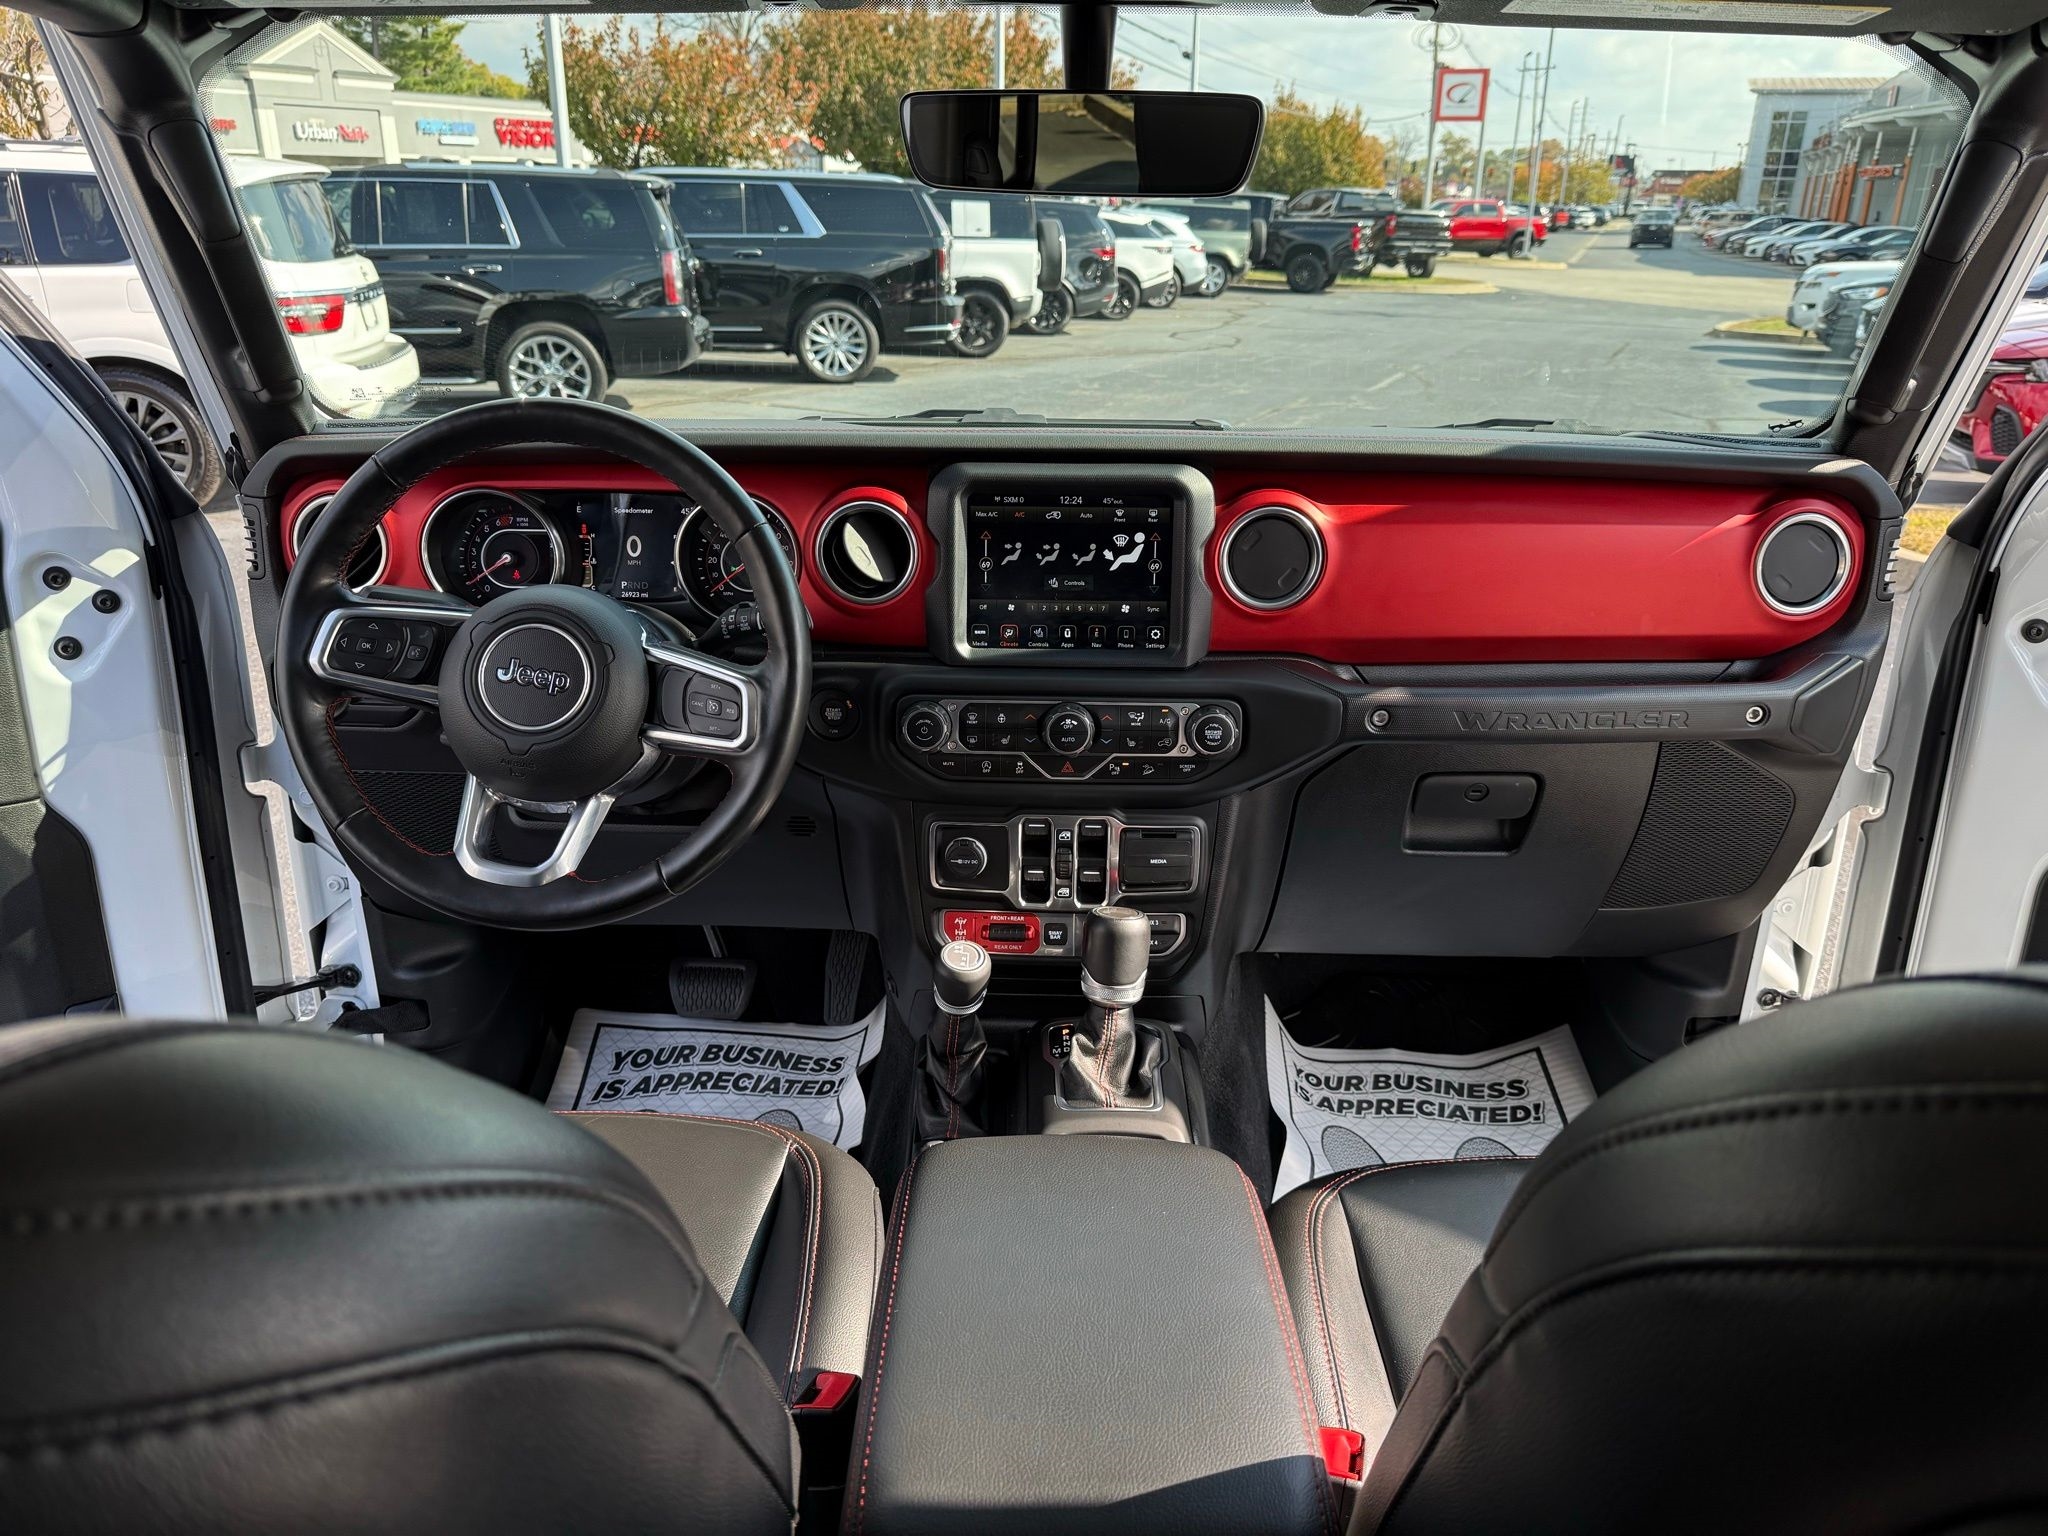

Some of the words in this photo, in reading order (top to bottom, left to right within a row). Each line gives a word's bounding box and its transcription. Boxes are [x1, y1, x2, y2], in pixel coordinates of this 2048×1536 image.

[295, 121, 337, 141] Urban
[338, 124, 370, 142] Nails
[496, 127, 556, 148] VISION
[1059, 496, 1083, 505] 12:24
[614, 506, 654, 514] Speedometer
[484, 525, 490, 533] 5
[471, 547, 477, 556] 3
[626, 535, 642, 558] 0
[712, 543, 721, 551] 30
[471, 561, 477, 569] 2
[707, 556, 718, 564] 20
[981, 560, 991, 568] 69
[1150, 562, 1160, 570] 69
[496, 657, 571, 696] Jeep
[1454, 710, 1689, 732] WRANGLER
[610, 1044, 698, 1073] YOUR
[698, 1044, 847, 1075] BUSINESS
[590, 1079, 628, 1103] IS
[625, 1071, 847, 1098] APPRECIATED!
[1293, 1062, 1366, 1093] YOUR
[1370, 1073, 1528, 1101] BUSINESS
[1294, 1080, 1313, 1106] IS
[1315, 1095, 1545, 1125] APPRECIATED!
